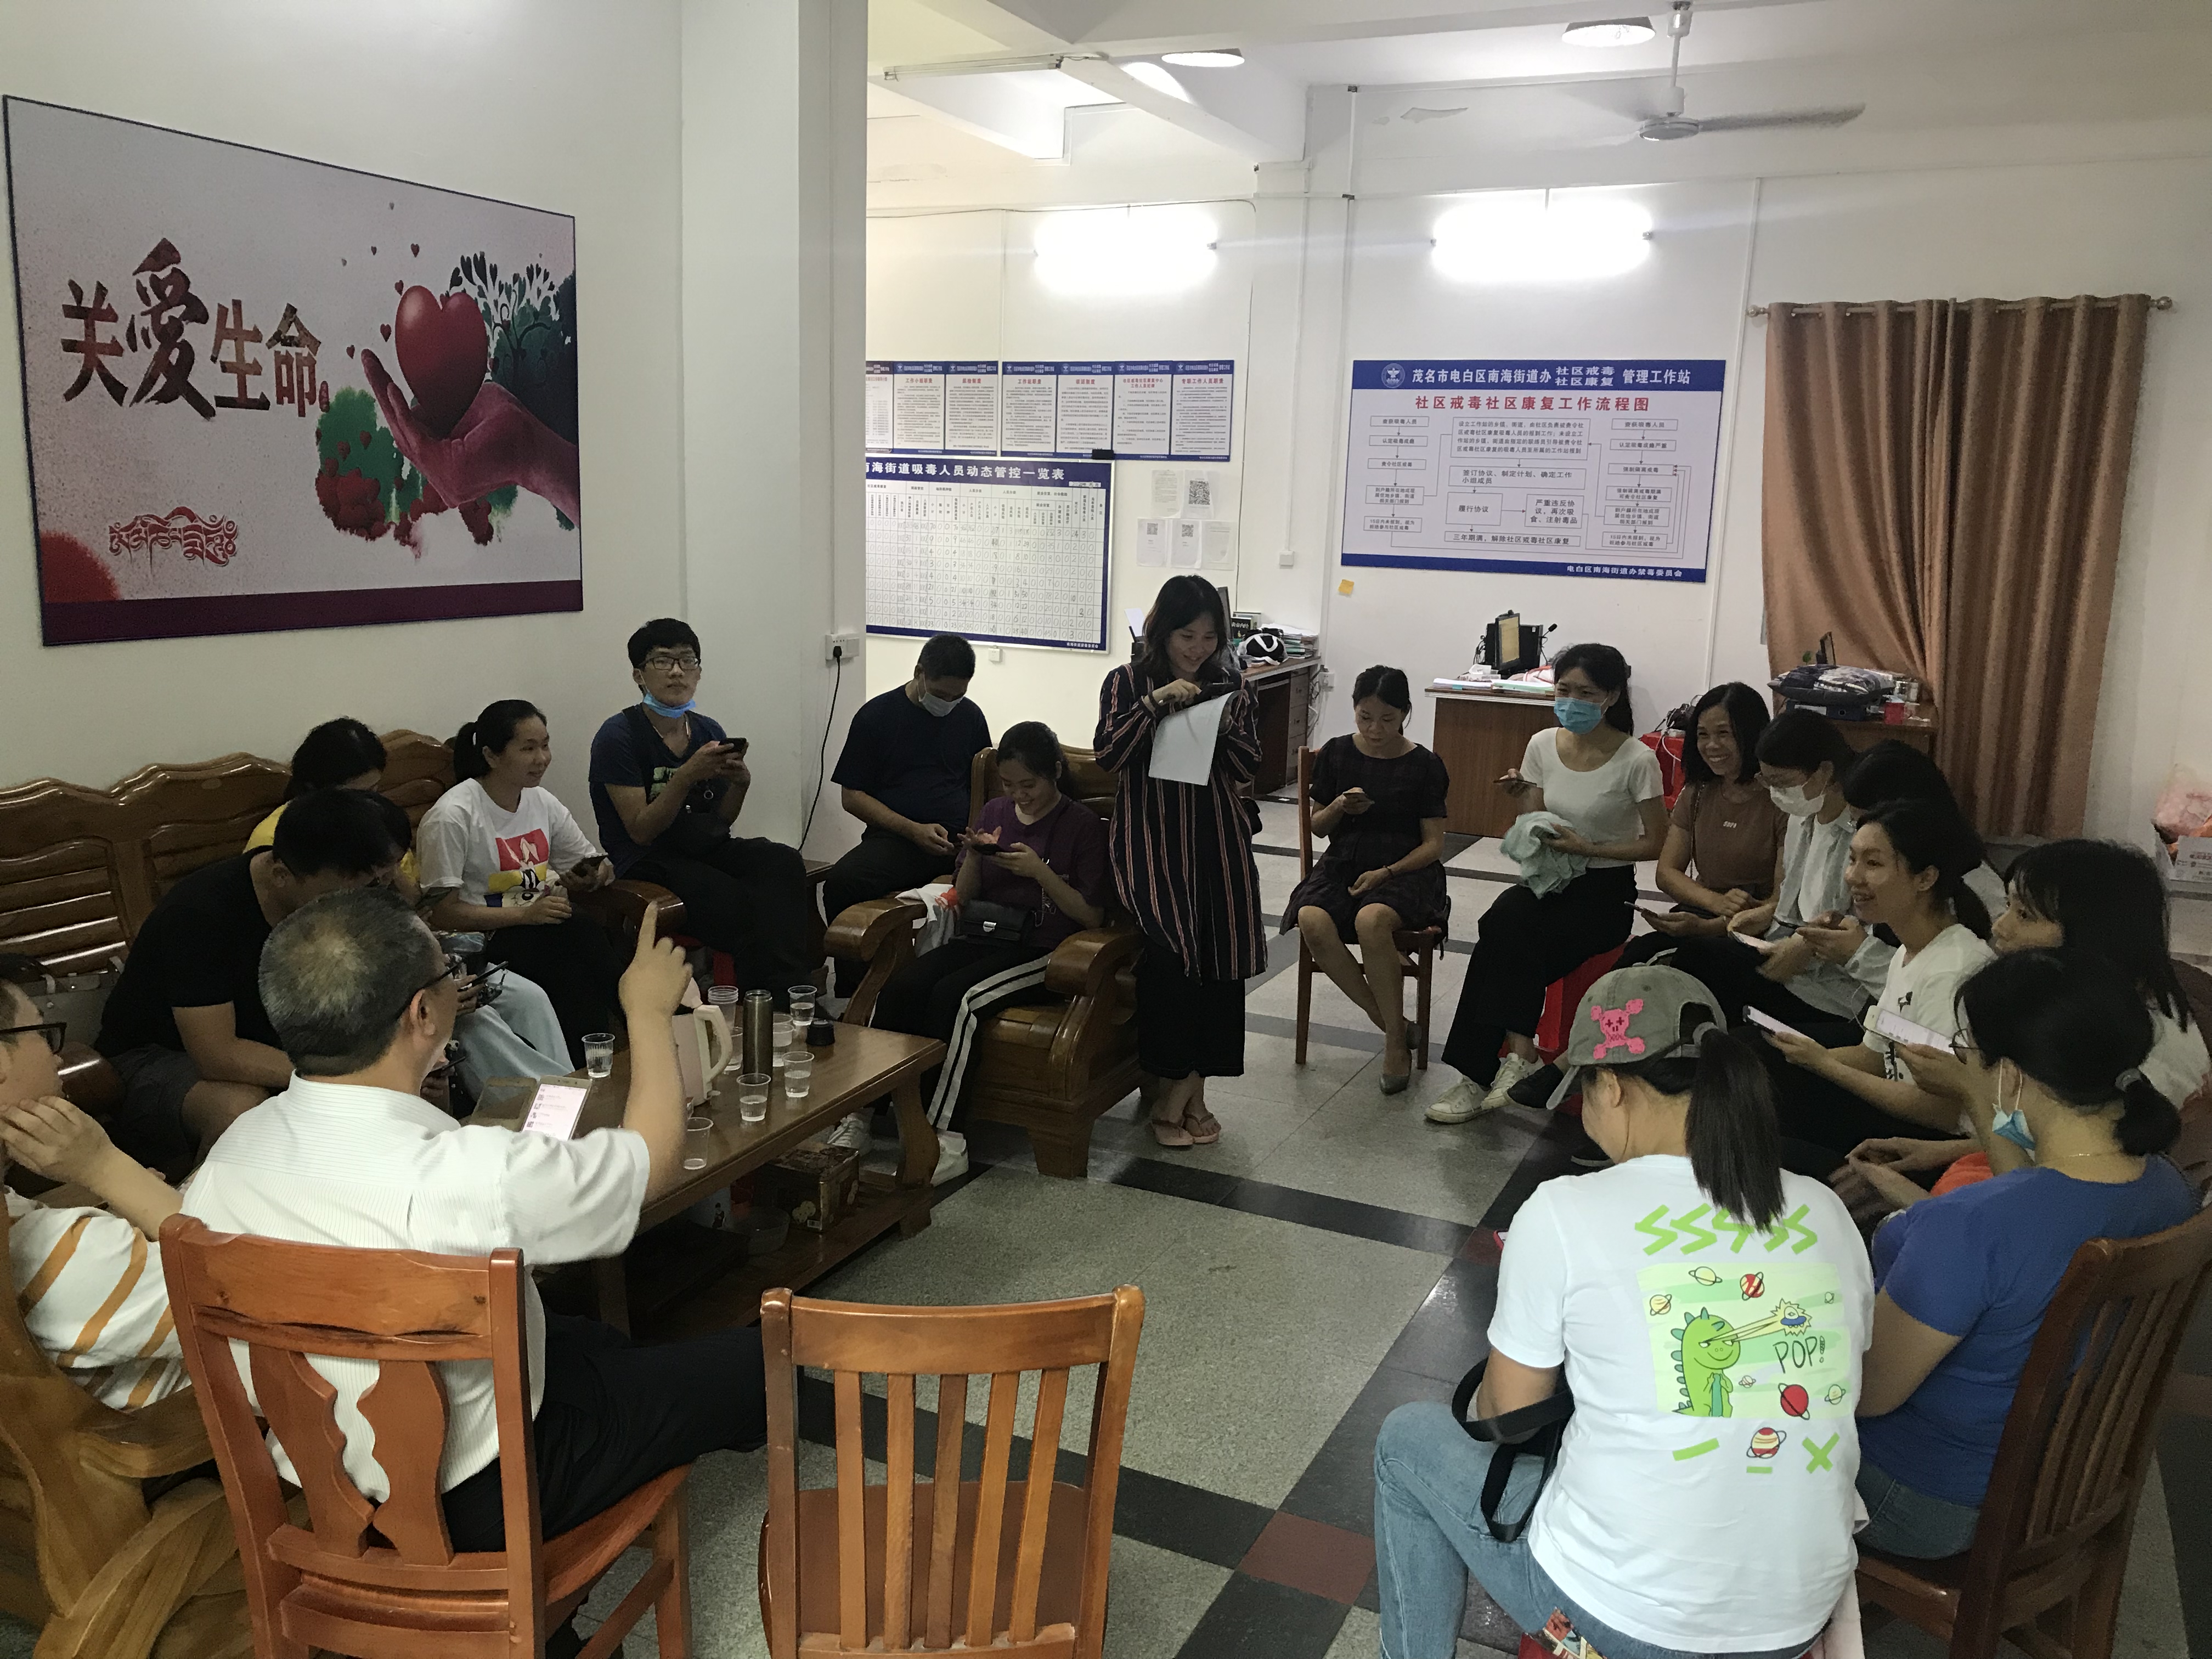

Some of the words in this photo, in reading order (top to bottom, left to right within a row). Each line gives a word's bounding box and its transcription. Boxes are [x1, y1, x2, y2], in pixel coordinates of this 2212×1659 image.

[1412, 369, 1552, 383] 茂名市电白区南海街道办
[1556, 366, 1615, 376] 社区戒毒
[1623, 369, 1691, 384] 管理工作站
[1554, 377, 1614, 386] 社区康复
[1415, 396, 1649, 411] 社区戒毒社区康复工作流程图
[1453, 534, 1569, 545] 三年期满，解除社区戒毒社区康复
[1567, 566, 1682, 577] 电白区南海街道办禁毒委员会
[1773, 1336, 1825, 1374] POP!
